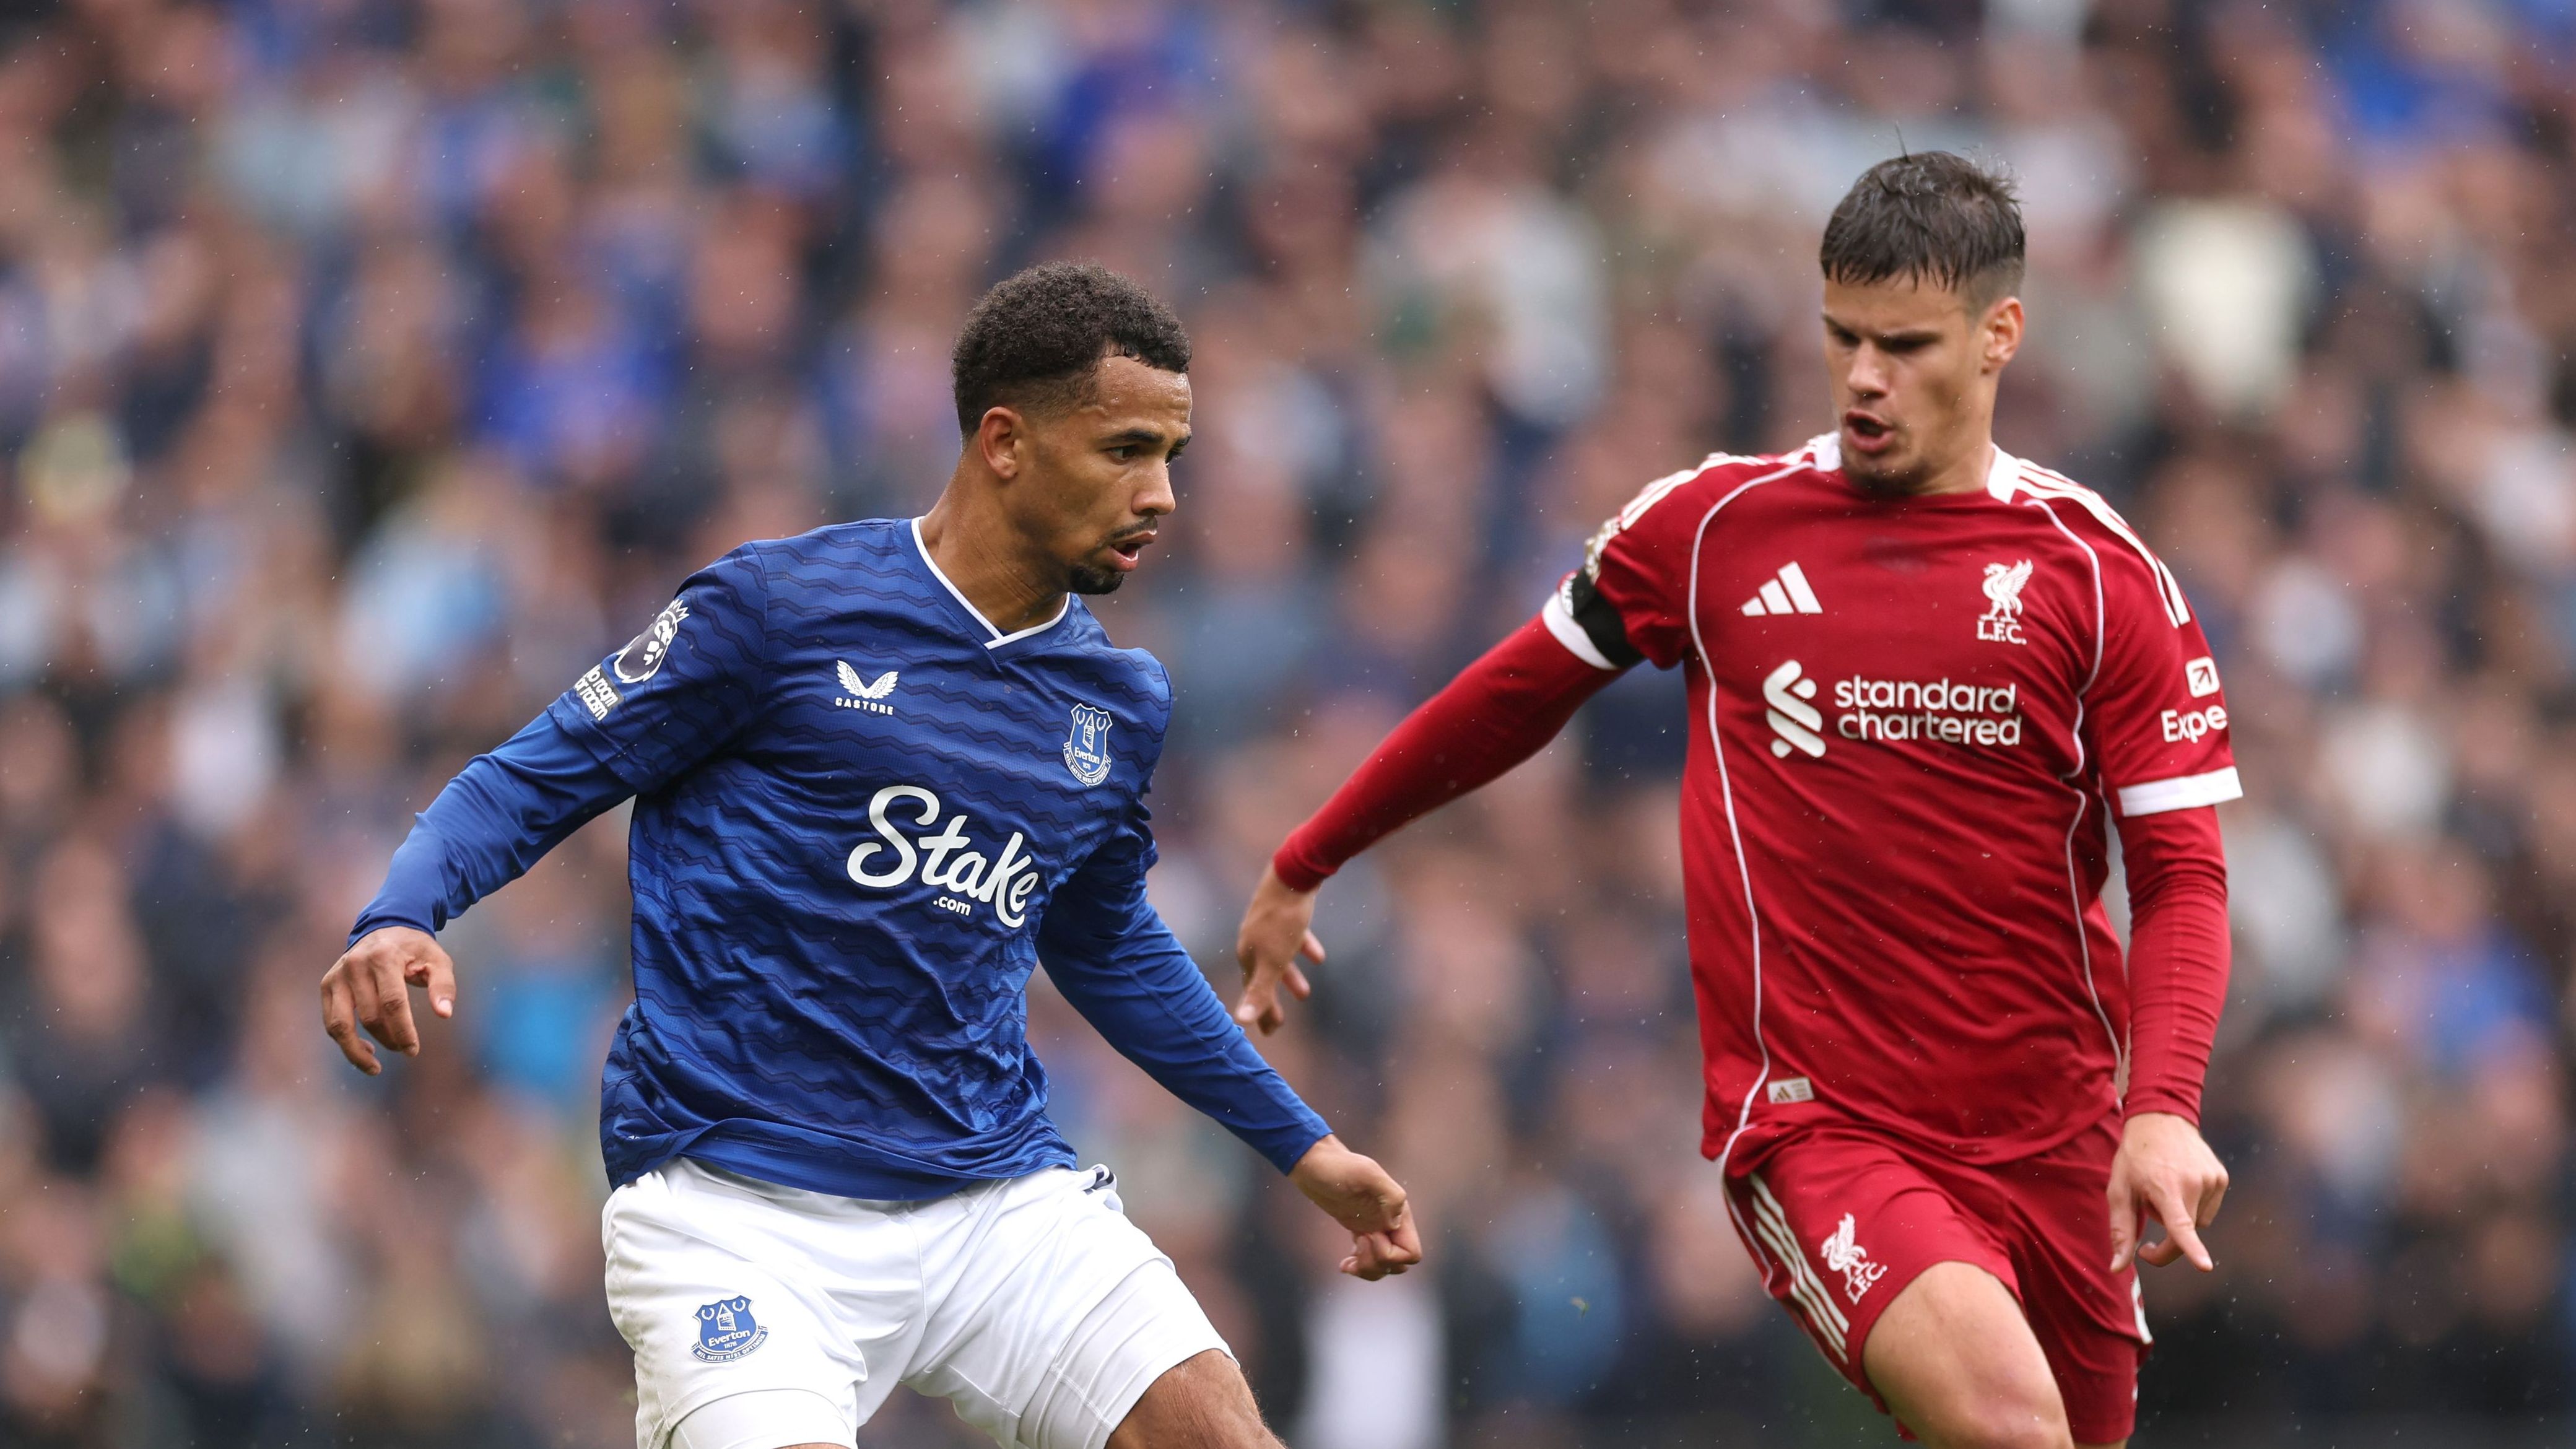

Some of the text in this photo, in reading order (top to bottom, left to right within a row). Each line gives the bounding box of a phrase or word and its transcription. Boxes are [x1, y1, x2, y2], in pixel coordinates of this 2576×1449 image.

[593, 677, 618, 707] room
[835, 697, 894, 715] CASTORE
[1834, 674, 2016, 713] standard
[1838, 709, 2022, 746] chartered
[2160, 705, 2227, 744] Expe
[1074, 746, 1100, 765] Everton
[847, 785, 1039, 928] Stake
[933, 896, 971, 916] .com
[696, 1351, 705, 1359] NIL
[742, 1333, 766, 1354] OPTIMUM
[708, 1330, 751, 1347] Everton
